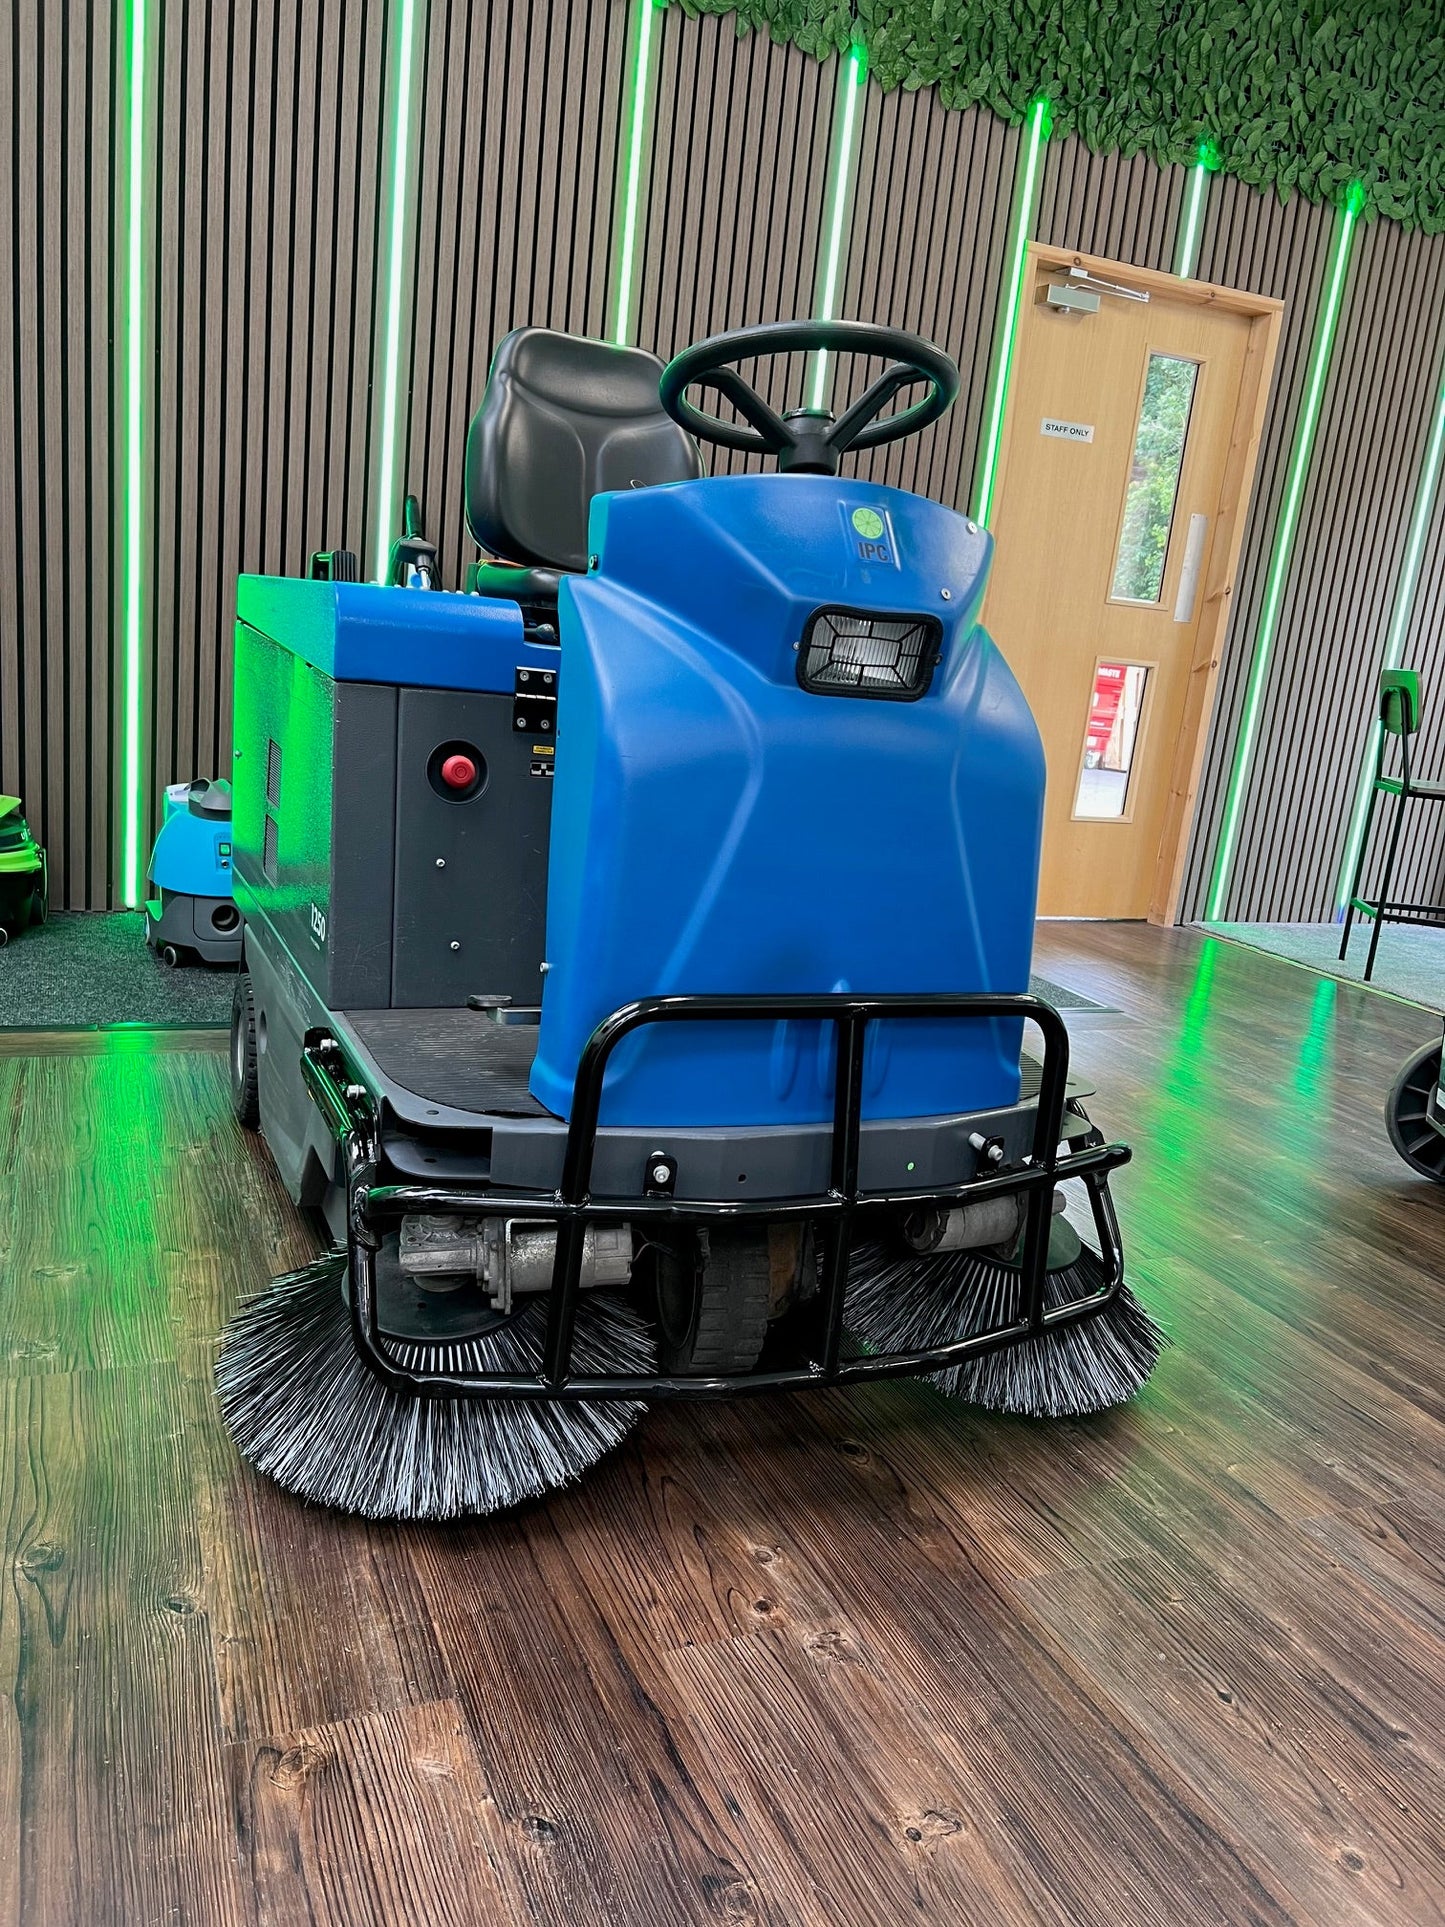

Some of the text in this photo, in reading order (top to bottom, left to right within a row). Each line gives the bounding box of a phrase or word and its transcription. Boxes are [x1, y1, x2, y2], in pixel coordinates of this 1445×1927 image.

[1045, 423, 1089, 437] STAFF ONLY
[858, 541, 888, 561] IPC
[311, 902, 326, 942] 1250
